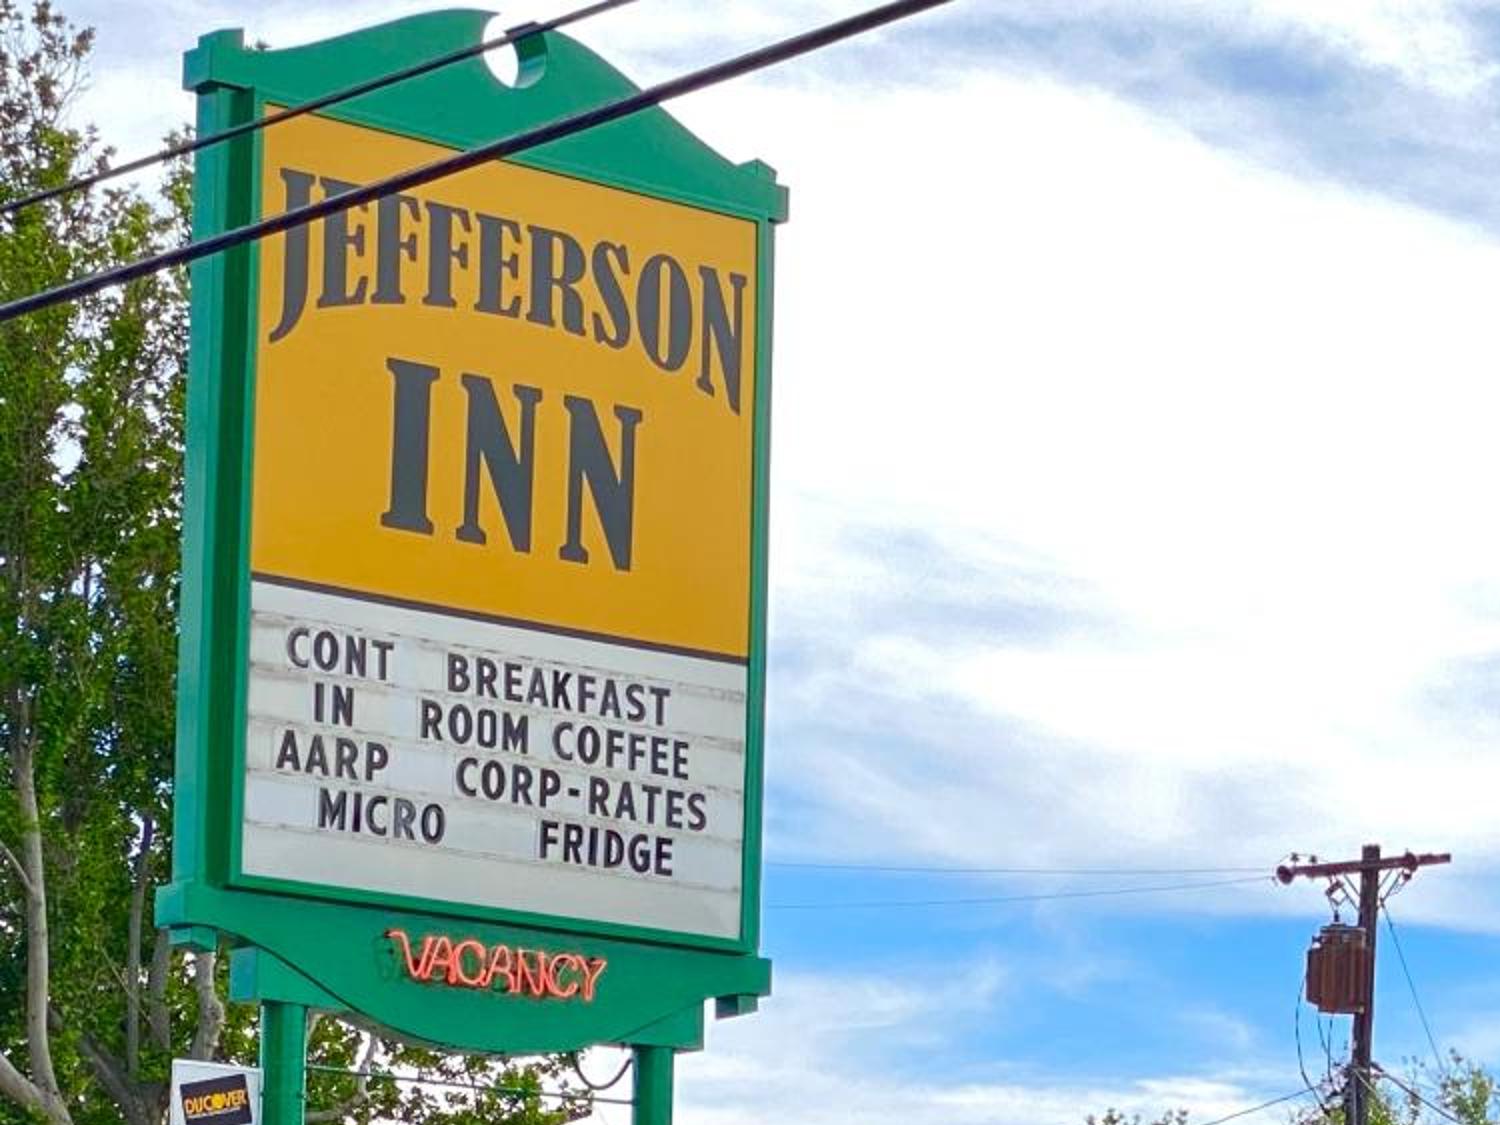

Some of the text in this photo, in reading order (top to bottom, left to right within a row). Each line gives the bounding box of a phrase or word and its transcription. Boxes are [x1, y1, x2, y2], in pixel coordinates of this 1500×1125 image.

[268, 167, 748, 415] JEFFERSON
[379, 357, 644, 573] INN
[286, 627, 671, 727] CONT BREAKFAST
[275, 730, 708, 832] AARP CORP-RATES
[314, 683, 690, 780] IN ROOM COFFEE
[316, 787, 674, 877] MICRO FRIDGE
[386, 929, 607, 1001] VACANCY
